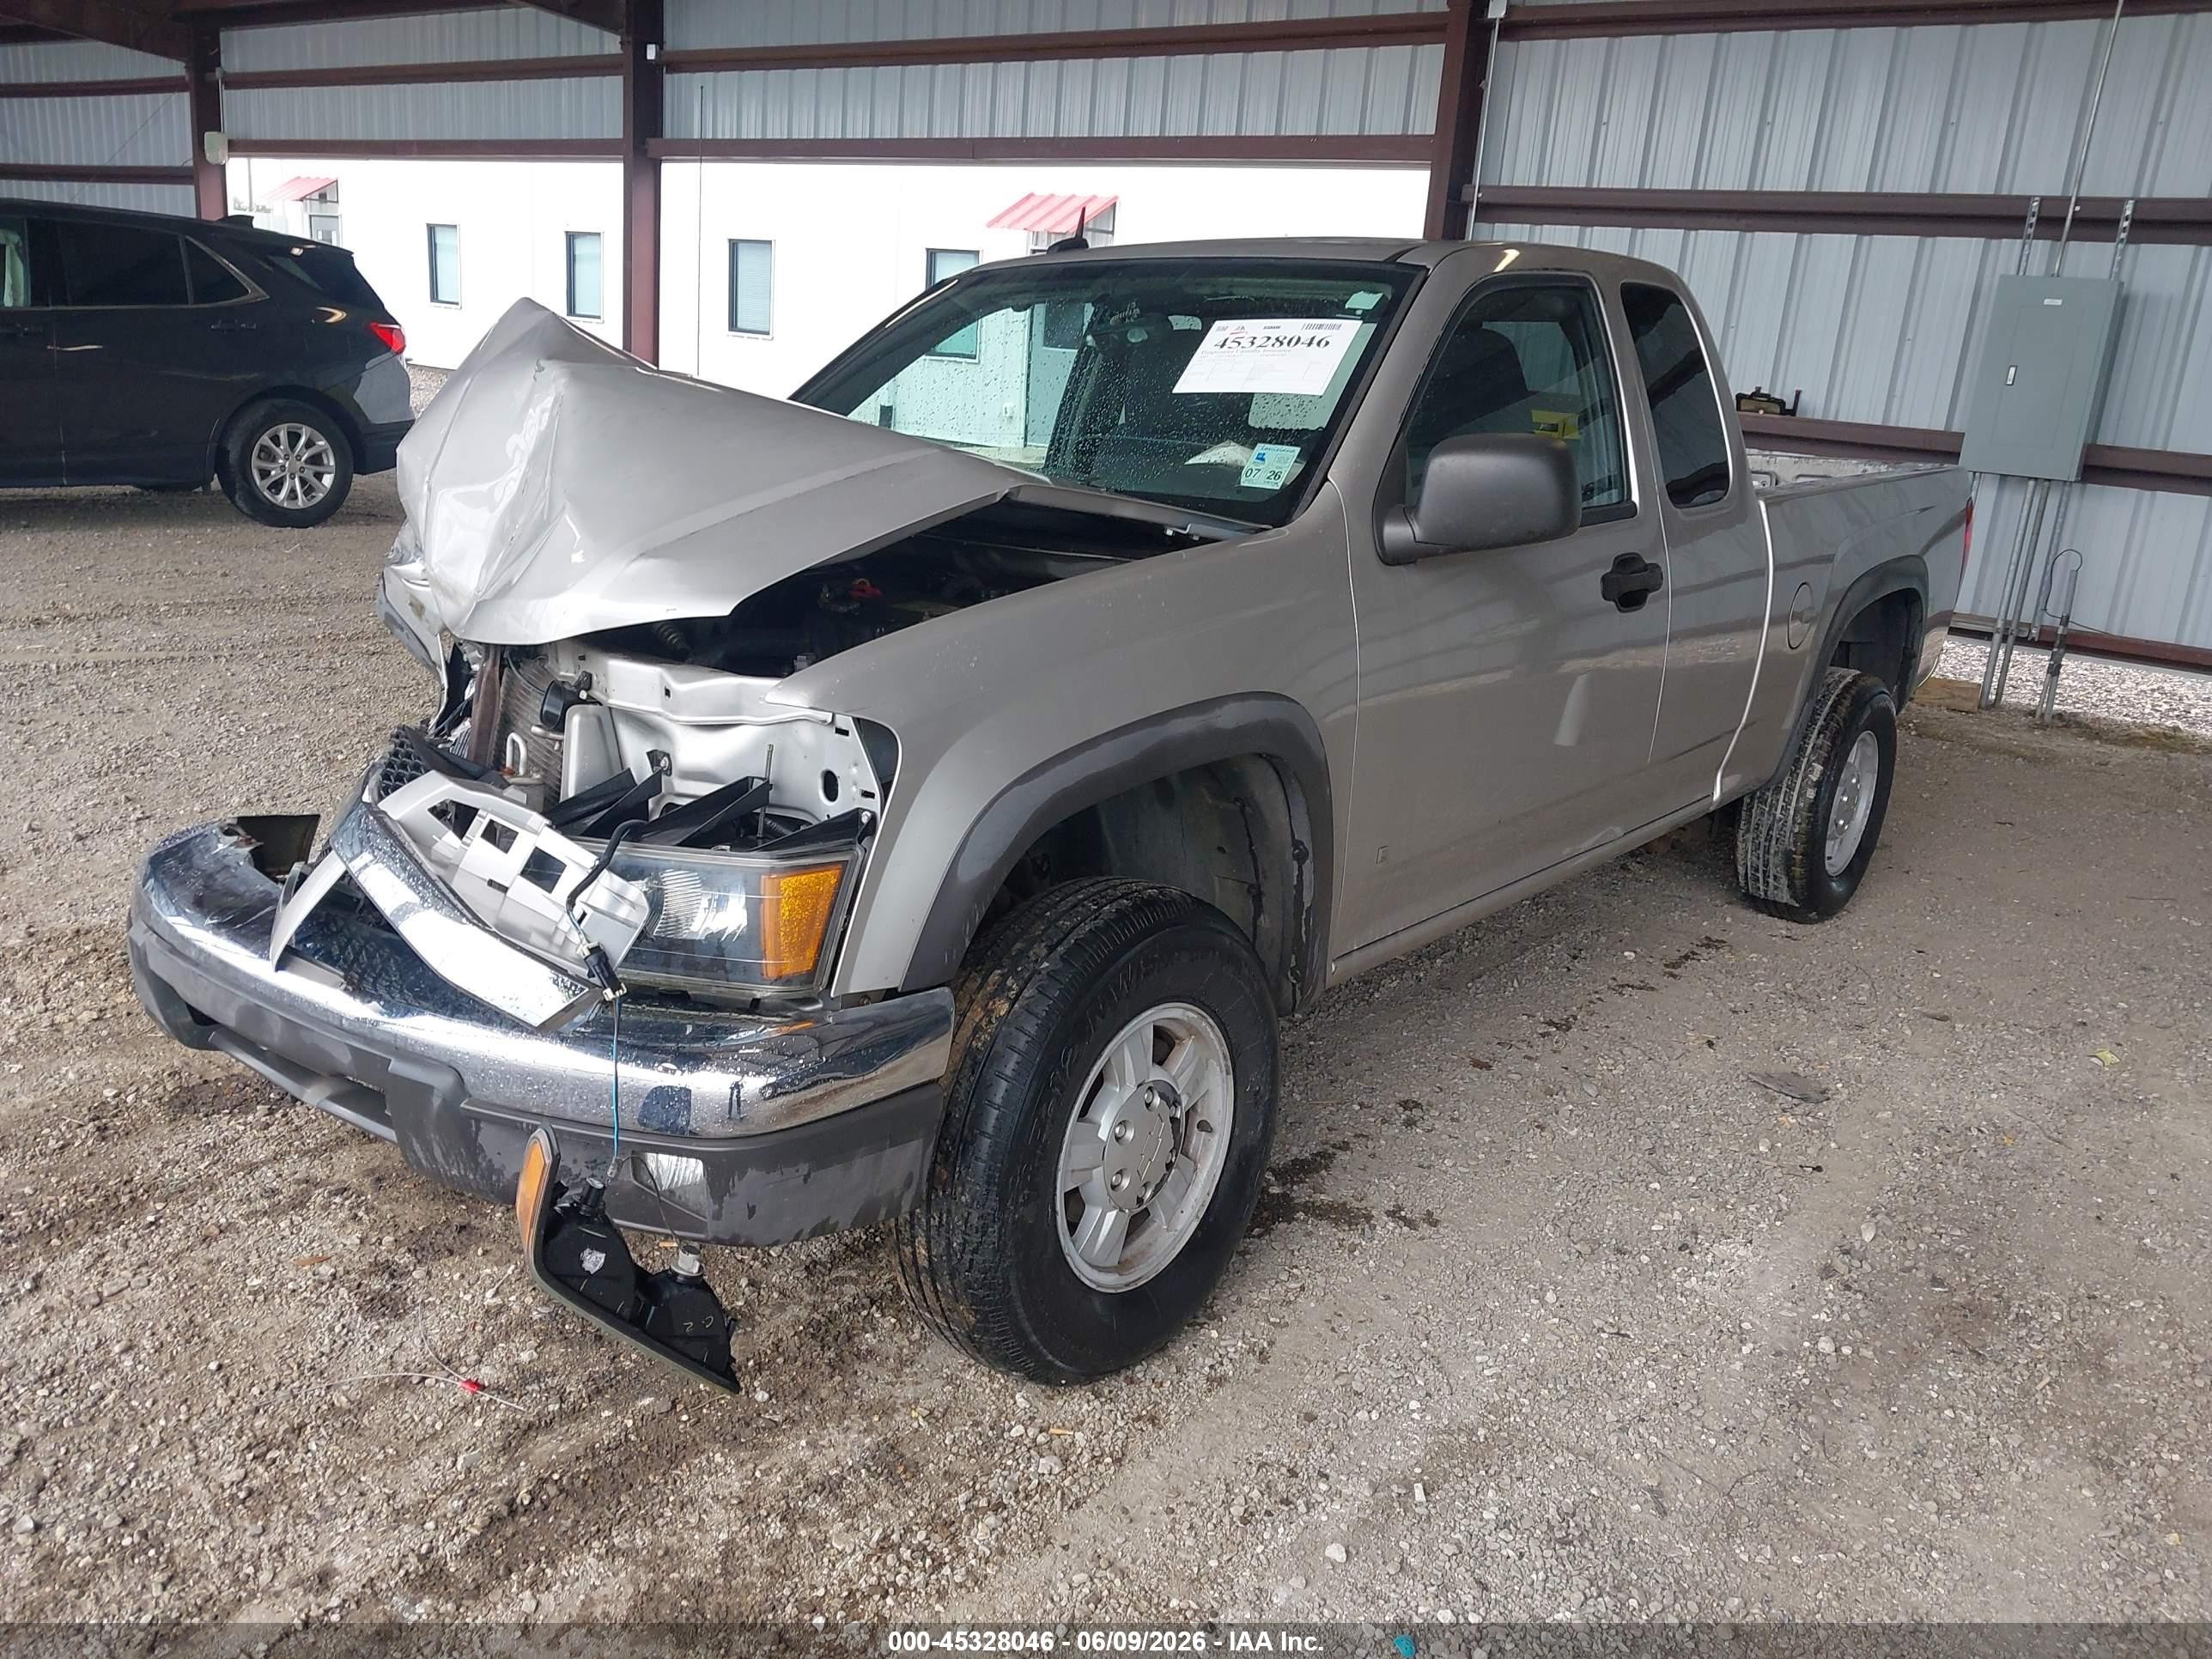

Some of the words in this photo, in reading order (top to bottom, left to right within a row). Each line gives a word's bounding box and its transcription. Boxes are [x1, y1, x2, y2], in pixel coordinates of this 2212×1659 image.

[1214, 334, 1331, 349] 45328046
[1245, 468, 1261, 478] 07
[1267, 470, 1283, 481] 26
